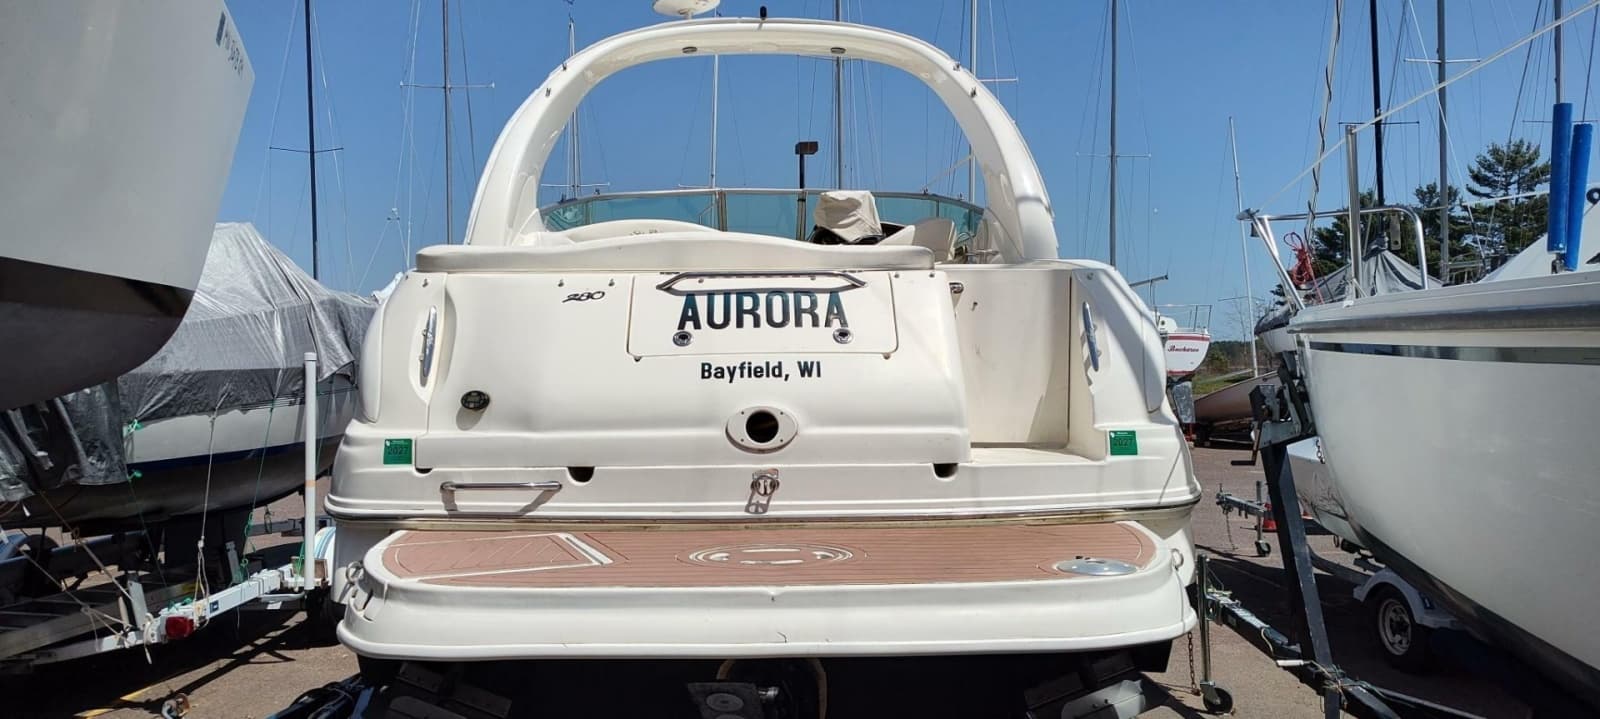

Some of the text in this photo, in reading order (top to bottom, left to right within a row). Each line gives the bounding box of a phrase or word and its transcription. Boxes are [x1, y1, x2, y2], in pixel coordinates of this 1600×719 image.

[562, 291, 605, 303] 280
[677, 290, 849, 330] AURORA
[701, 361, 821, 384] Bayfield, WI
